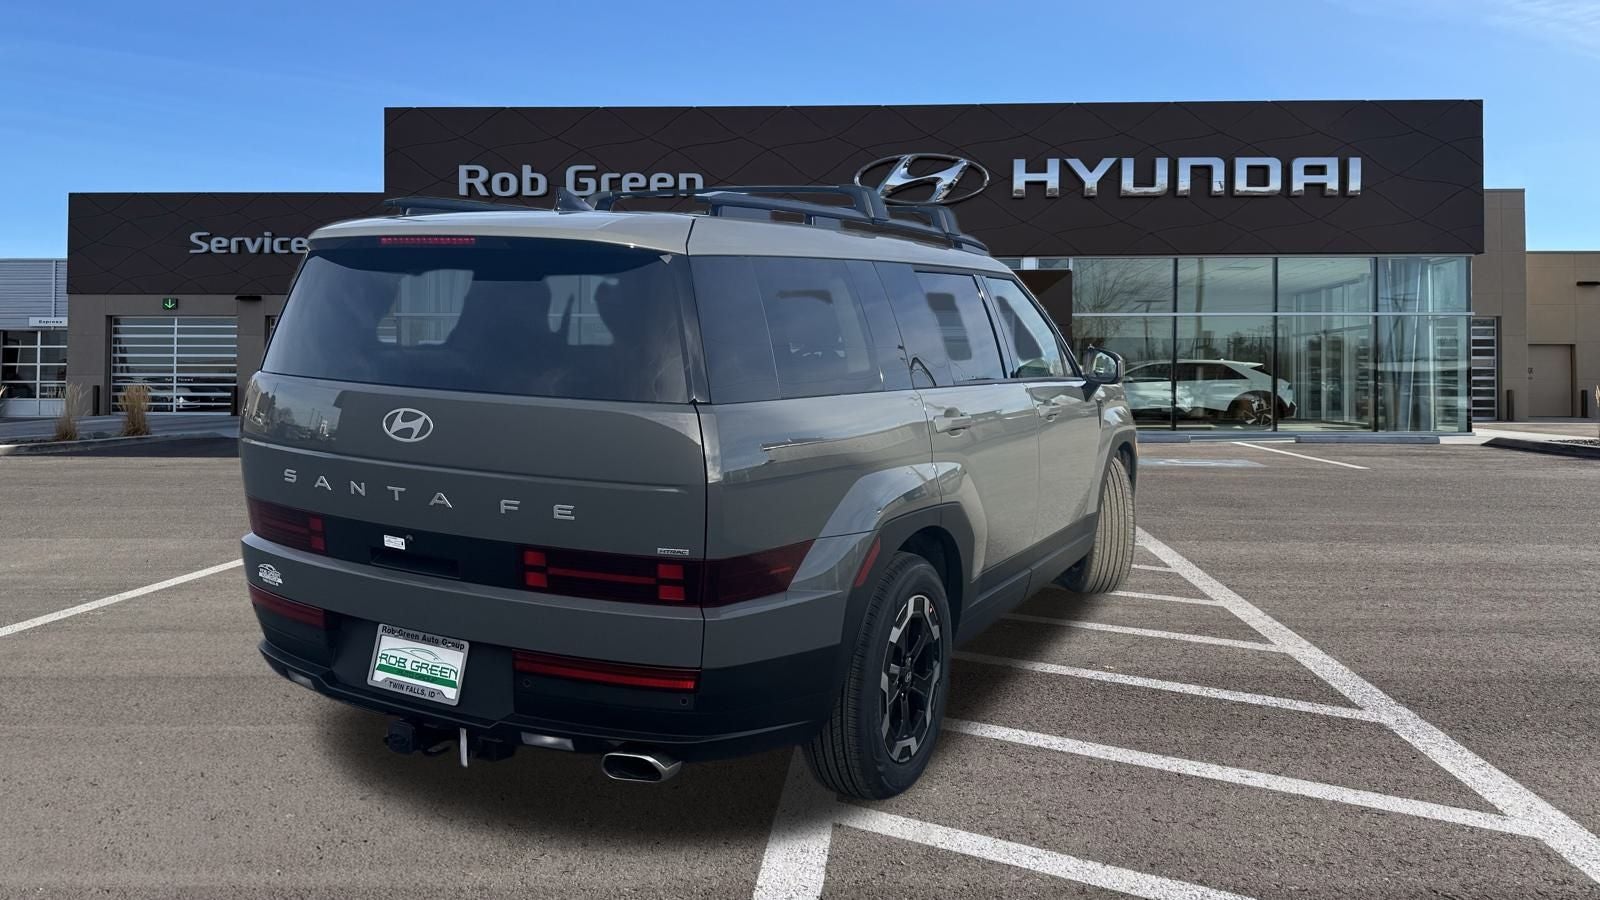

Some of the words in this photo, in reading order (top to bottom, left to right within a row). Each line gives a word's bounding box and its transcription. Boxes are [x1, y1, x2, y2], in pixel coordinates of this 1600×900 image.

[458, 164, 548, 197] Rob
[565, 164, 704, 197] Green
[1012, 157, 1362, 197] HYUNDAI
[189, 231, 308, 254] Service
[283, 468, 453, 509] SANTA
[500, 500, 575, 521] FE
[422, 635, 439, 644] Auto
[441, 639, 465, 650] Group
[379, 653, 407, 668] ROB
[410, 660, 458, 680] GREEN
[389, 681, 404, 690] TWIN
[405, 685, 426, 697] FALLS,
